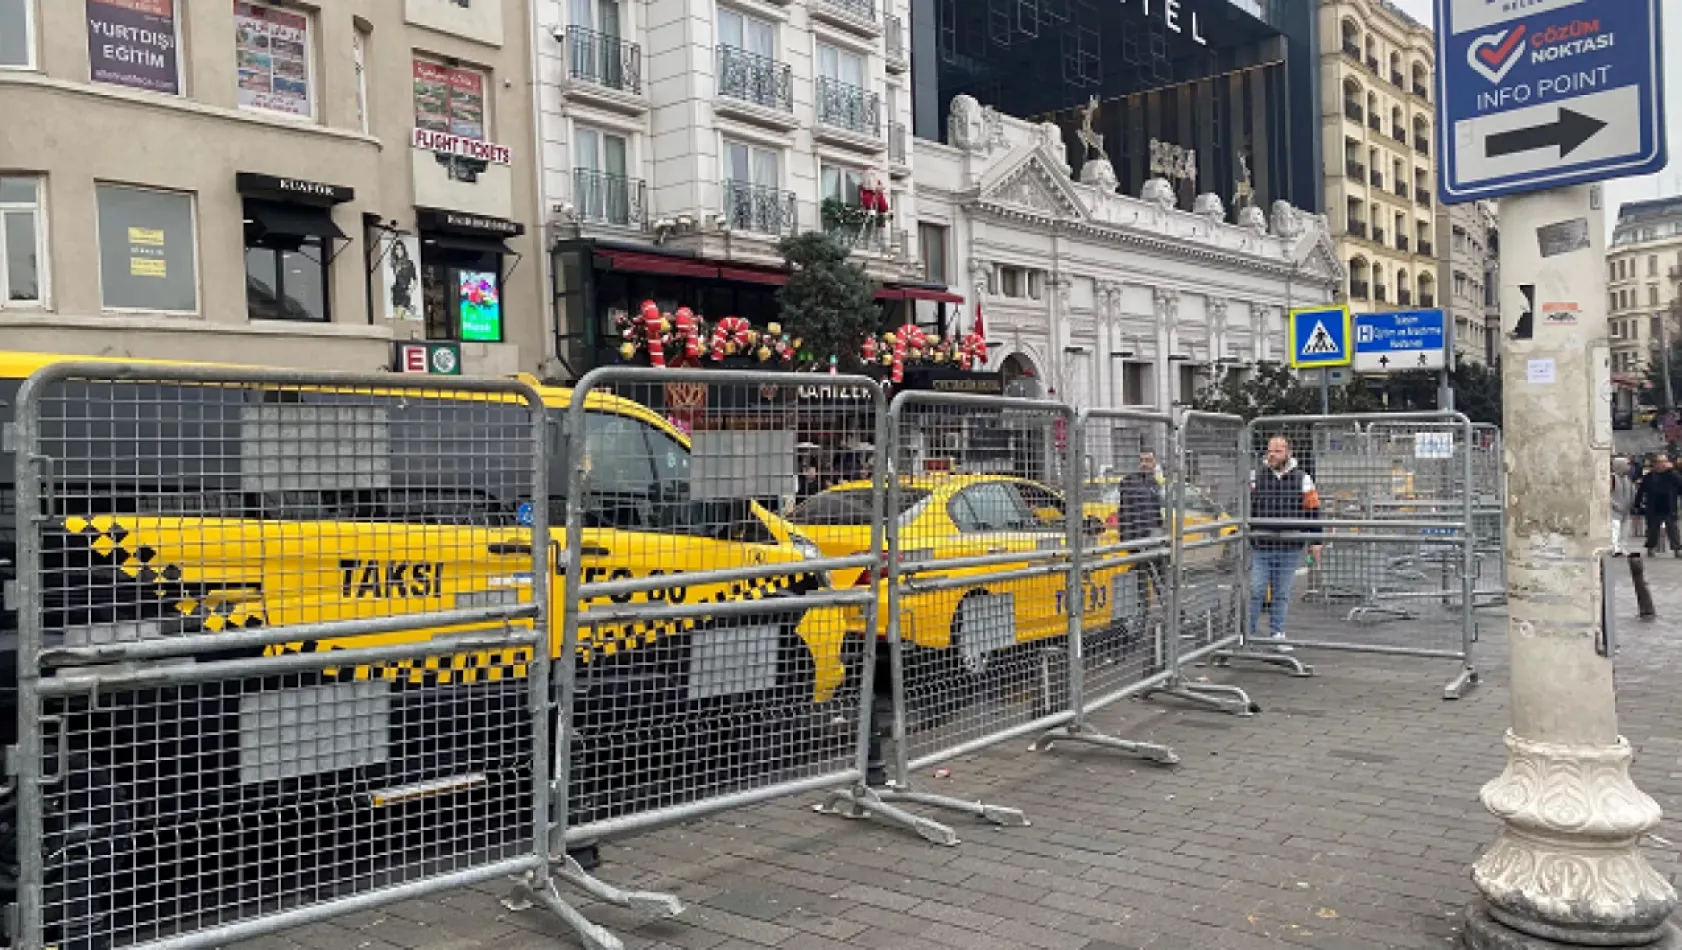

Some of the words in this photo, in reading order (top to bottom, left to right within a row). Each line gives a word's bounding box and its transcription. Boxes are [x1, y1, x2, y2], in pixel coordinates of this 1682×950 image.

[1530, 19, 1600, 49] ÇÖZÜM
[1531, 33, 1616, 65] NOKTASI
[102, 42, 165, 69] EĞİTİM
[1477, 83, 1532, 111] INFO
[1537, 64, 1613, 98] POINT
[415, 129, 460, 154] FLIGHT
[462, 139, 509, 164] TICKETS
[407, 348, 425, 371] E
[339, 558, 444, 599] TAKSI
